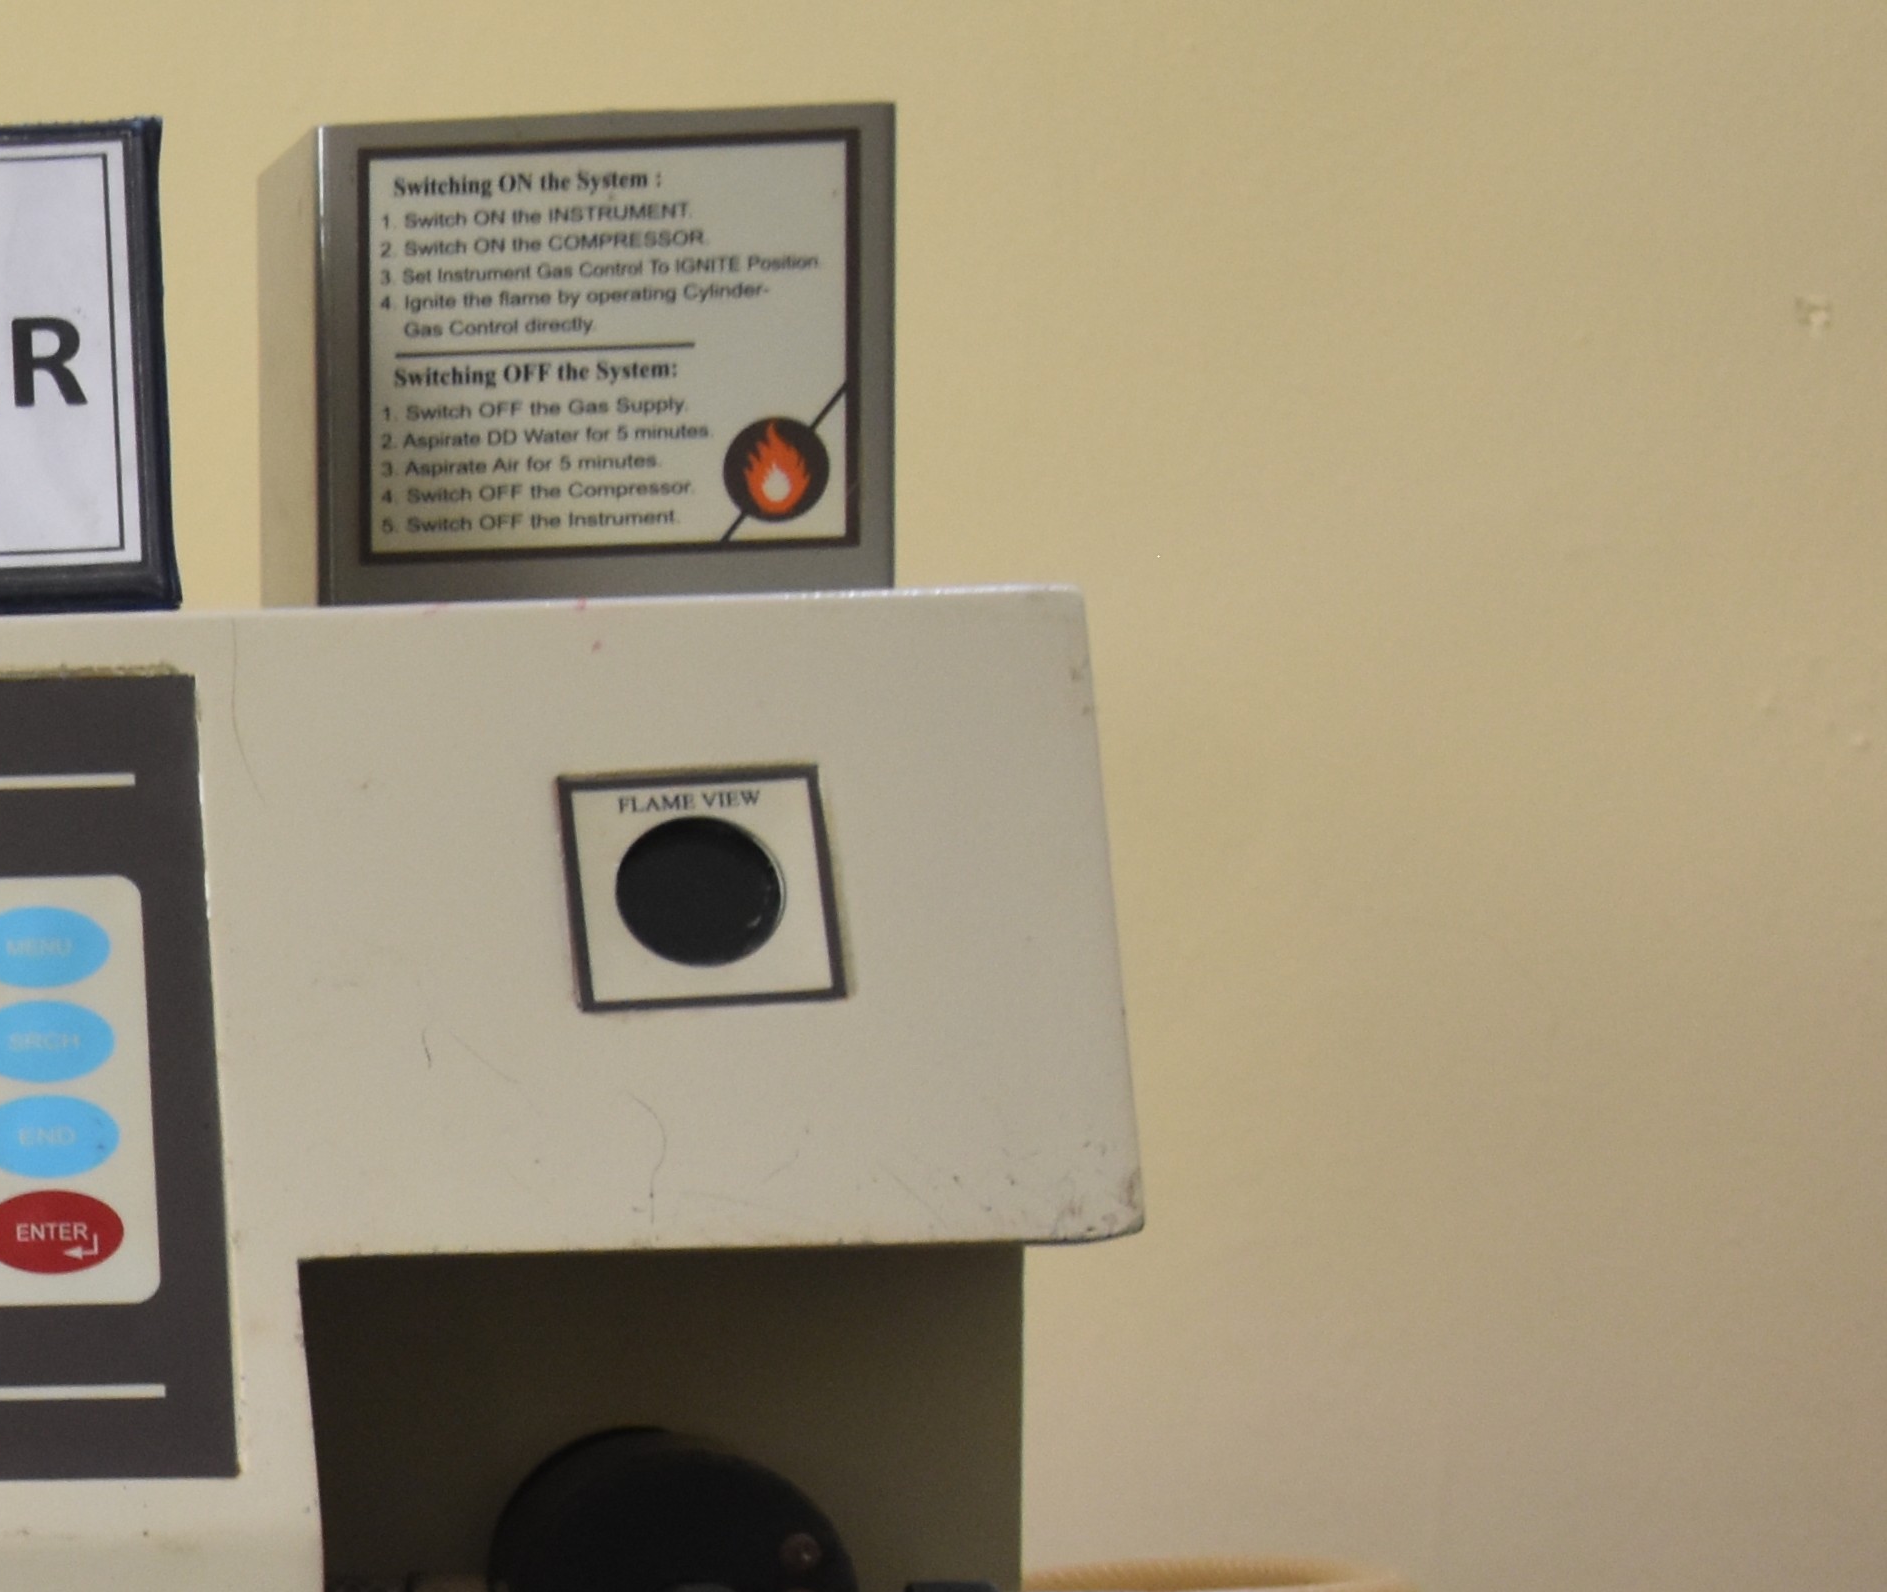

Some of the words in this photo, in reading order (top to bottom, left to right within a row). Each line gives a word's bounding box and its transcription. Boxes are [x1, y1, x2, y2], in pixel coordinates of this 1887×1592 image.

[393, 174, 493, 199] Switching
[498, 172, 533, 193] ON
[540, 171, 571, 192] the
[404, 211, 467, 229] Switch
[474, 209, 506, 227] ON
[512, 208, 542, 225] the
[404, 239, 467, 257] Switch
[474, 237, 506, 255] ON
[512, 236, 542, 252] the
[402, 267, 432, 285] Set
[437, 264, 531, 283] Instrument
[537, 262, 573, 280] Gas
[579, 260, 643, 279] Control
[651, 258, 670, 275] To
[676, 255, 740, 274] IGNITE
[404, 293, 456, 314] Ignite
[463, 292, 493, 309] the
[499, 289, 551, 307] flame
[558, 289, 581, 309] by
[586, 286, 677, 306] operating
[683, 282, 770, 303] Cylinder-
[403, 320, 443, 339] Gas
[449, 318, 519, 337] Control
[394, 366, 497, 389] Switching
[503, 363, 552, 383] OFF
[558, 362, 589, 382] the
[596, 361, 678, 385] System:
[406, 402, 472, 421] Switch
[479, 401, 523, 419] OFF
[530, 400, 561, 417] the
[568, 398, 609, 415] Gas
[403, 431, 481, 451] Aspirate
[487, 429, 517, 446] DD
[524, 427, 579, 445] Water
[586, 426, 610, 442] for
[617, 426, 628, 441] 5
[405, 458, 487, 478] Aspirate
[493, 457, 520, 474] Air
[527, 456, 552, 472] for
[560, 455, 571, 471] 5
[406, 485, 472, 504] Switch
[479, 484, 523, 502] OFF
[530, 484, 561, 499] the
[406, 515, 472, 533] Switch
[479, 513, 523, 531] OFF
[530, 512, 561, 529] the
[617, 793, 697, 814] FLAME
[703, 789, 761, 810] VIEW
[6, 939, 73, 958] MENU
[18, 1125, 77, 1147] END
[16, 1221, 89, 1243] ENTER
